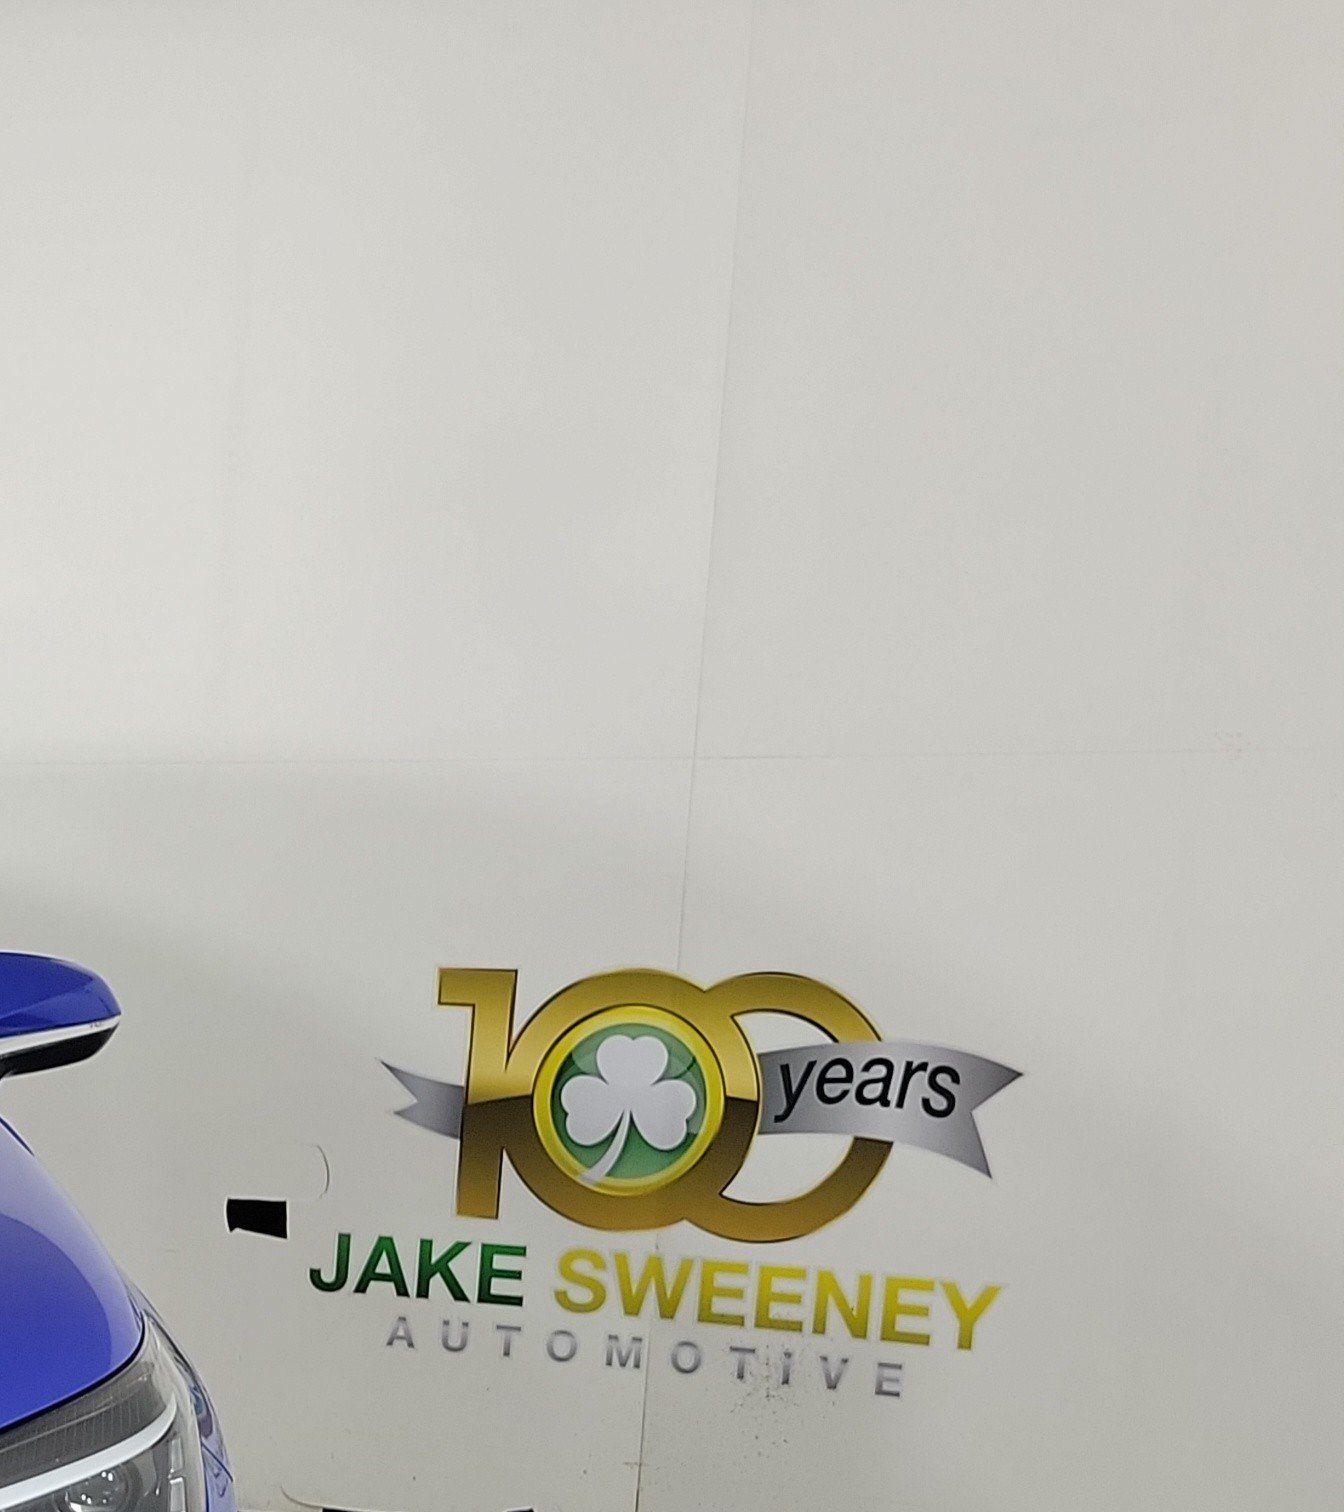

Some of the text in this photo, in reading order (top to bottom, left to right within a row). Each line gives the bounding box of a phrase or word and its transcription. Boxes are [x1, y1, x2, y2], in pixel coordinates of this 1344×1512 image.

[437, 968, 894, 1243] 100
[774, 1055, 962, 1122] years
[309, 1233, 1001, 1352] JAKE SWEENEY
[385, 1315, 905, 1398] AUTOMOTIVE
